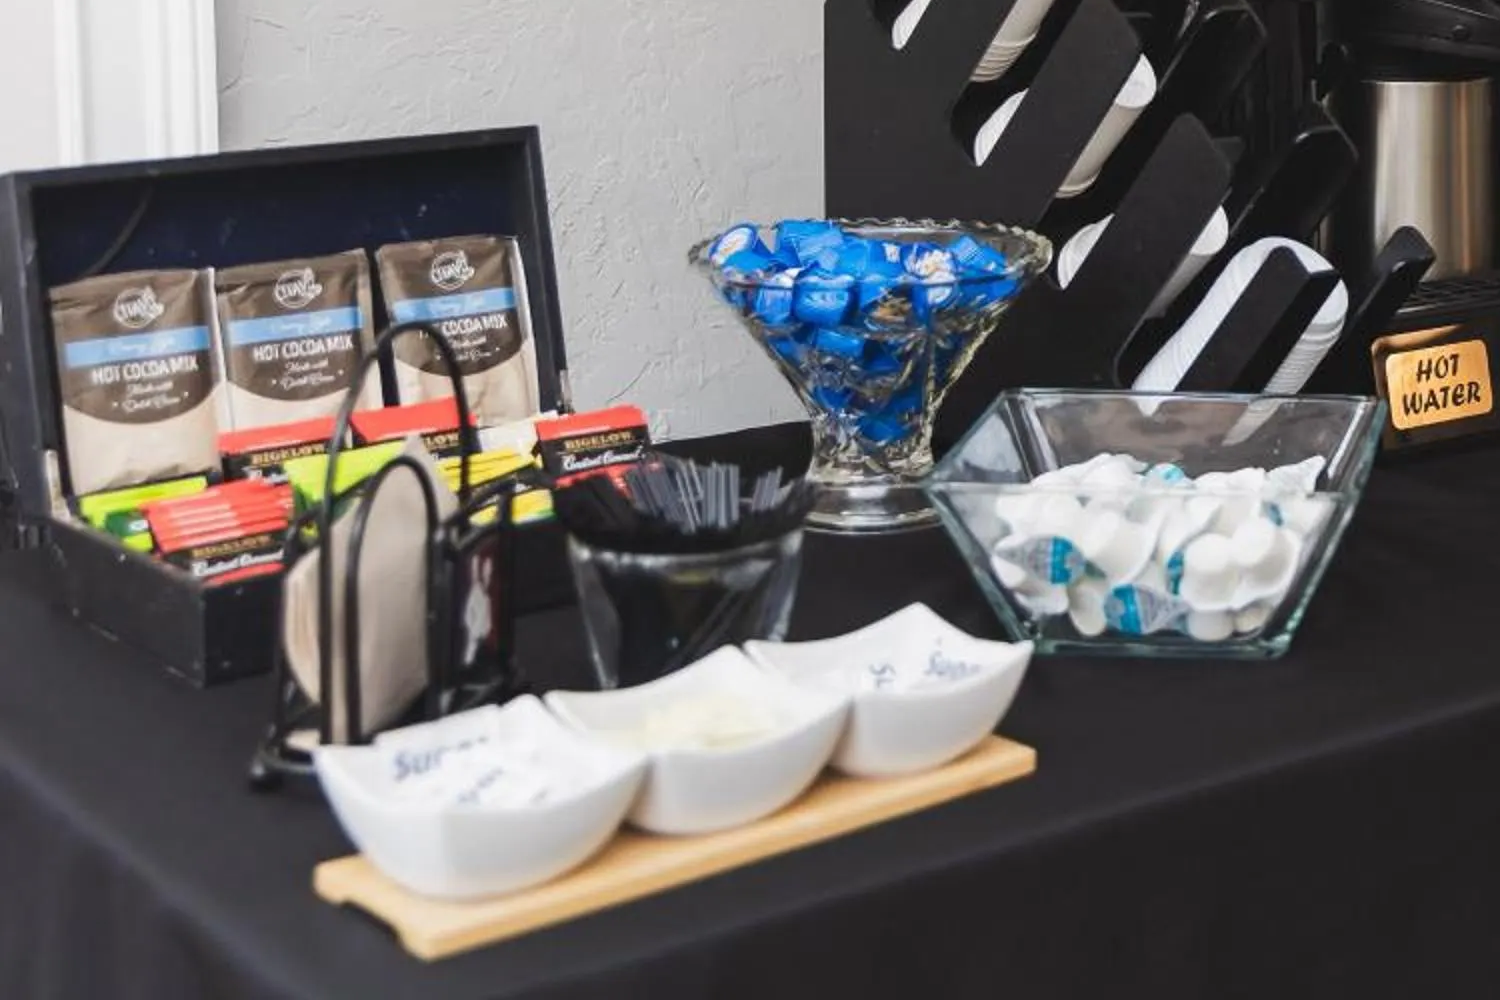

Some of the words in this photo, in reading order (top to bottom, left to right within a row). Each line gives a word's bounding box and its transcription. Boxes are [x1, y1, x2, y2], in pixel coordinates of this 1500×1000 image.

[252, 342, 281, 363] HOT
[281, 338, 327, 360] COCOA
[327, 333, 355, 354] MIX
[90, 363, 121, 386] HOT
[123, 358, 170, 382] COCOA
[171, 353, 200, 375] MIX
[1415, 353, 1460, 384] HOT
[1401, 380, 1482, 418] WATER
